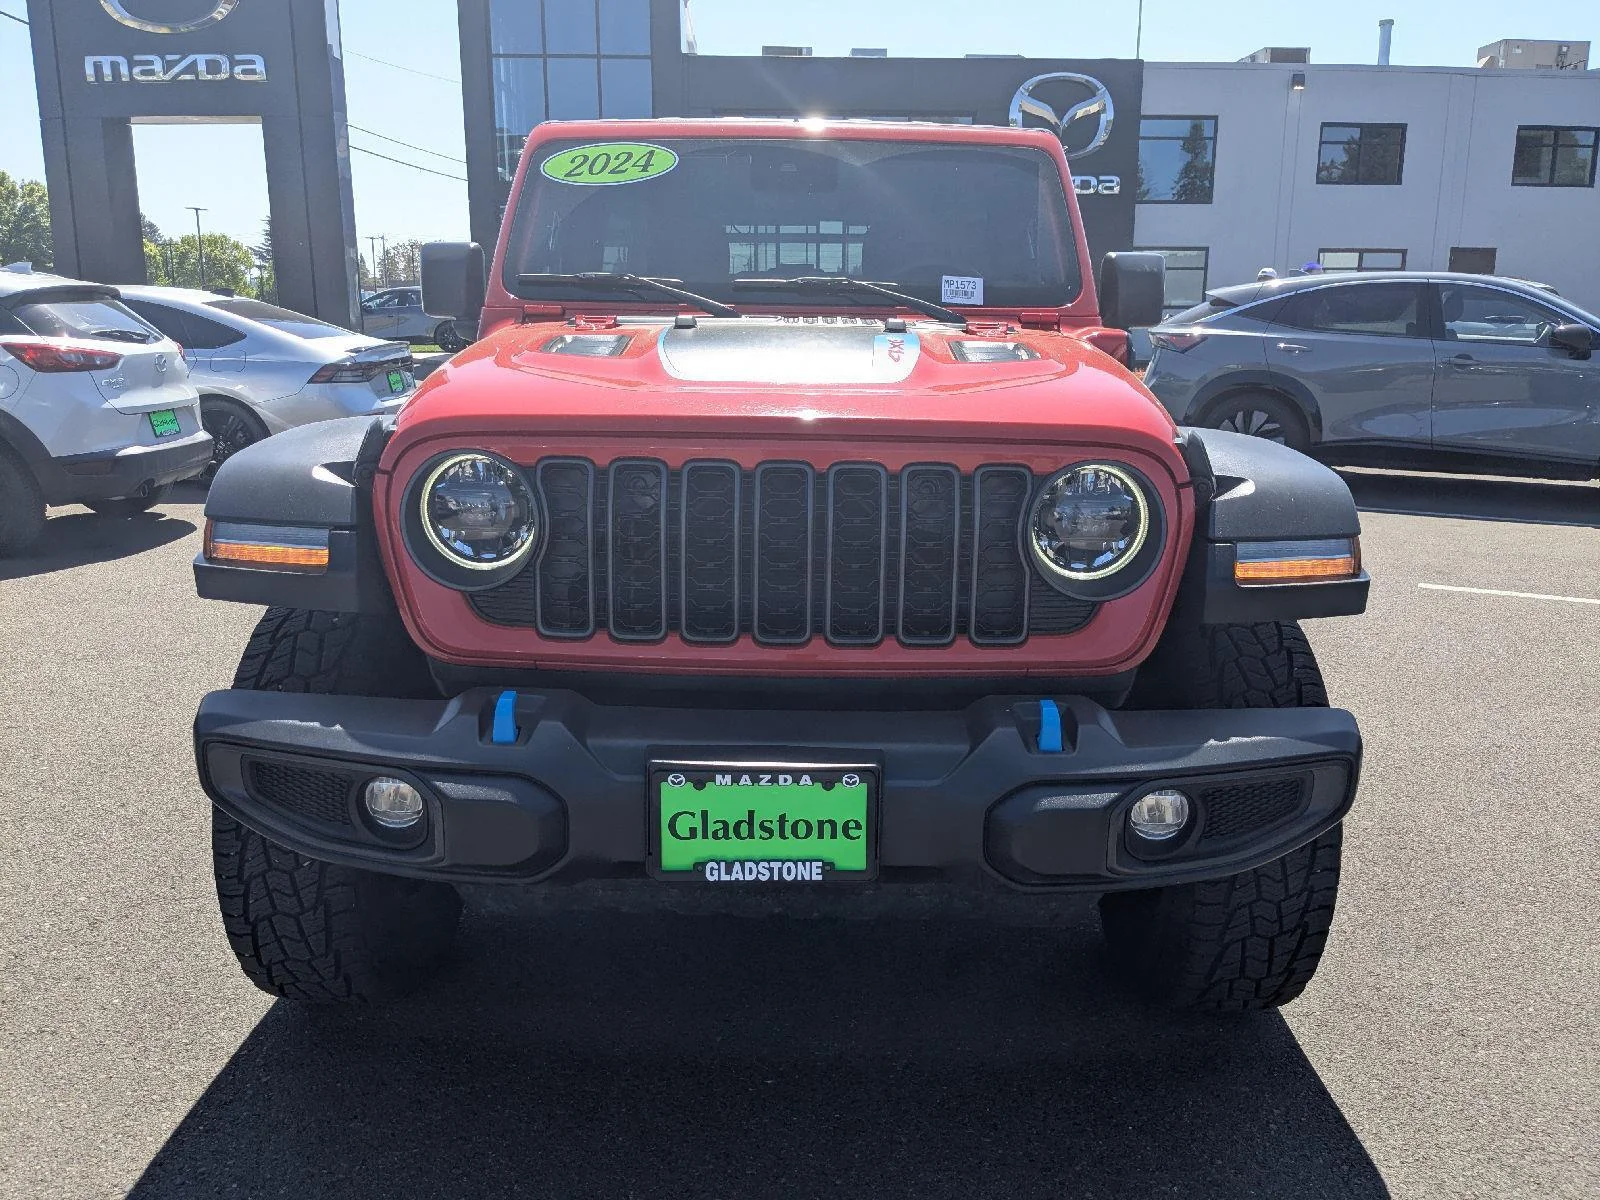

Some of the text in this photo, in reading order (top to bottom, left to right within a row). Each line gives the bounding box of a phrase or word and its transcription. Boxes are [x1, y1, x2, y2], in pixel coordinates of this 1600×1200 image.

[564, 149, 656, 178] 2024
[943, 279, 977, 290] MP1573
[715, 774, 813, 786] MAZDA
[667, 809, 863, 841] Gladstone
[705, 861, 823, 882] GLADSTONE
